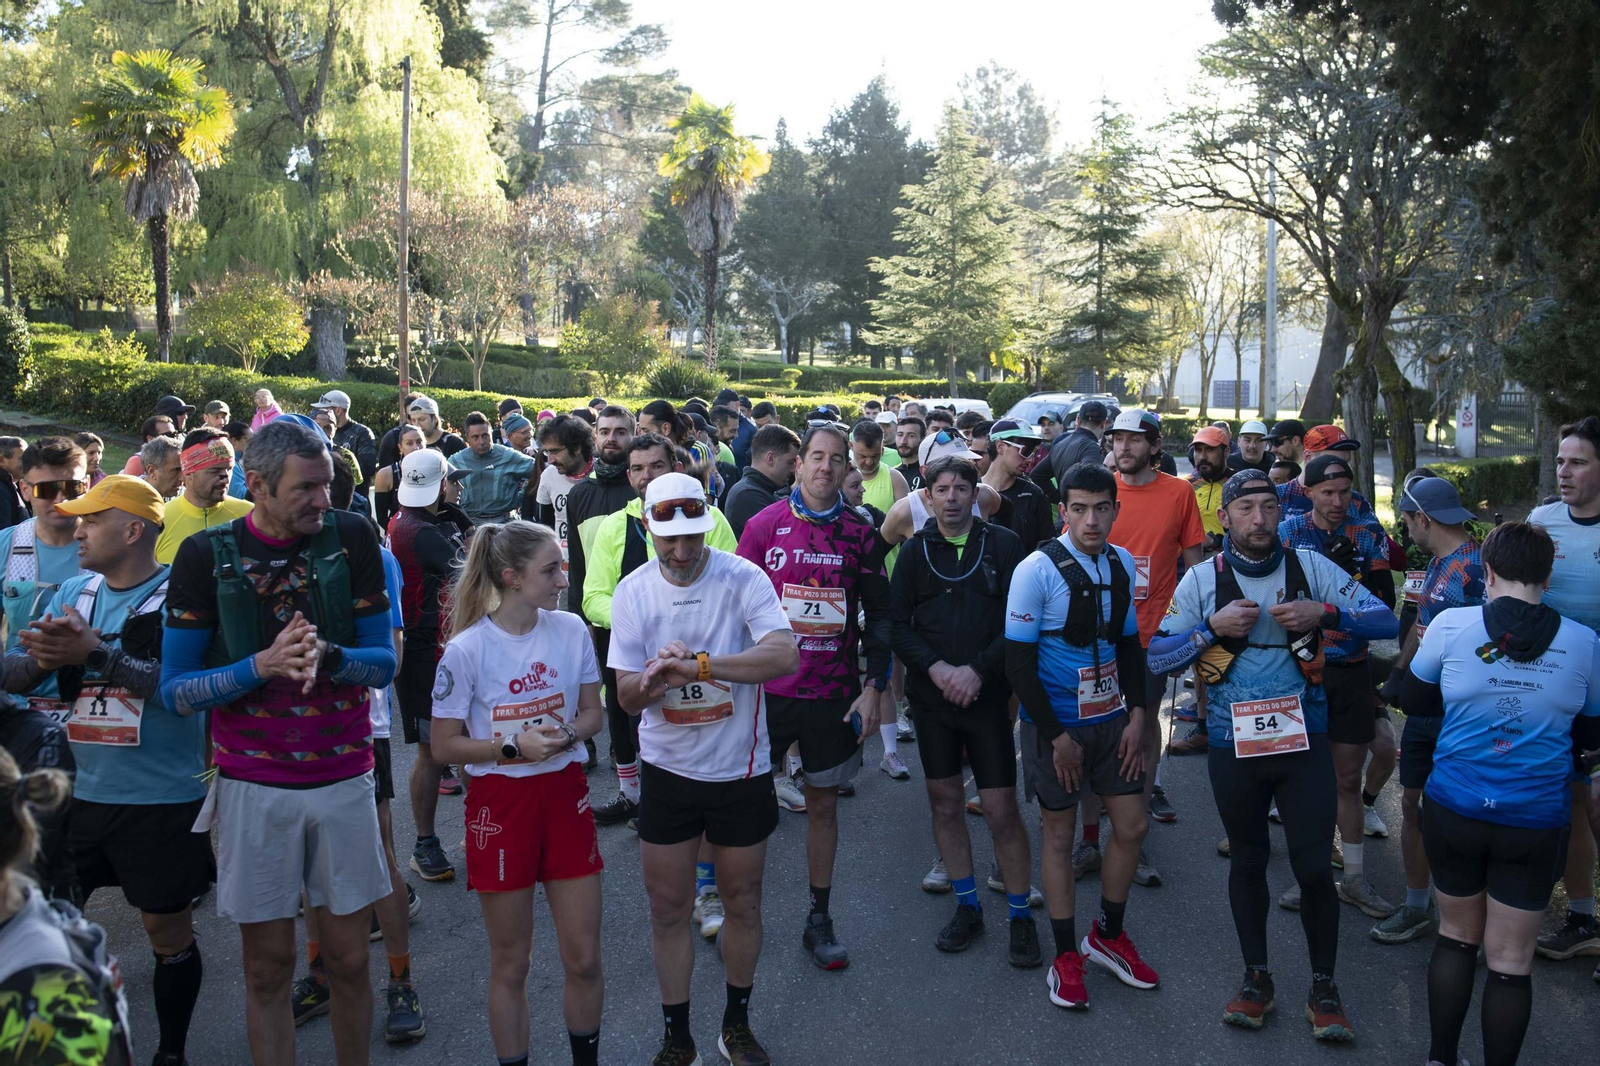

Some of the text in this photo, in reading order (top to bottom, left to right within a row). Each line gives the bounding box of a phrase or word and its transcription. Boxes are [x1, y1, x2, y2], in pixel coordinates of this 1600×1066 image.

[911, 476, 921, 490] 9
[555, 494, 567, 512] Co
[1412, 580, 1423, 589] 37
[804, 602, 821, 616] 71
[1159, 653, 1178, 667] TRAIL
[1177, 643, 1195, 661] RUN
[680, 684, 703, 700] 18
[1093, 677, 1112, 694] 102
[89, 700, 109, 716] 11
[496, 708, 518, 717] TRAIL
[519, 706, 538, 716] POZO
[539, 703, 547, 711] DO
[1254, 703, 1270, 712] POZO
[1281, 700, 1297, 708] DEMO
[1255, 715, 1278, 731] 54
